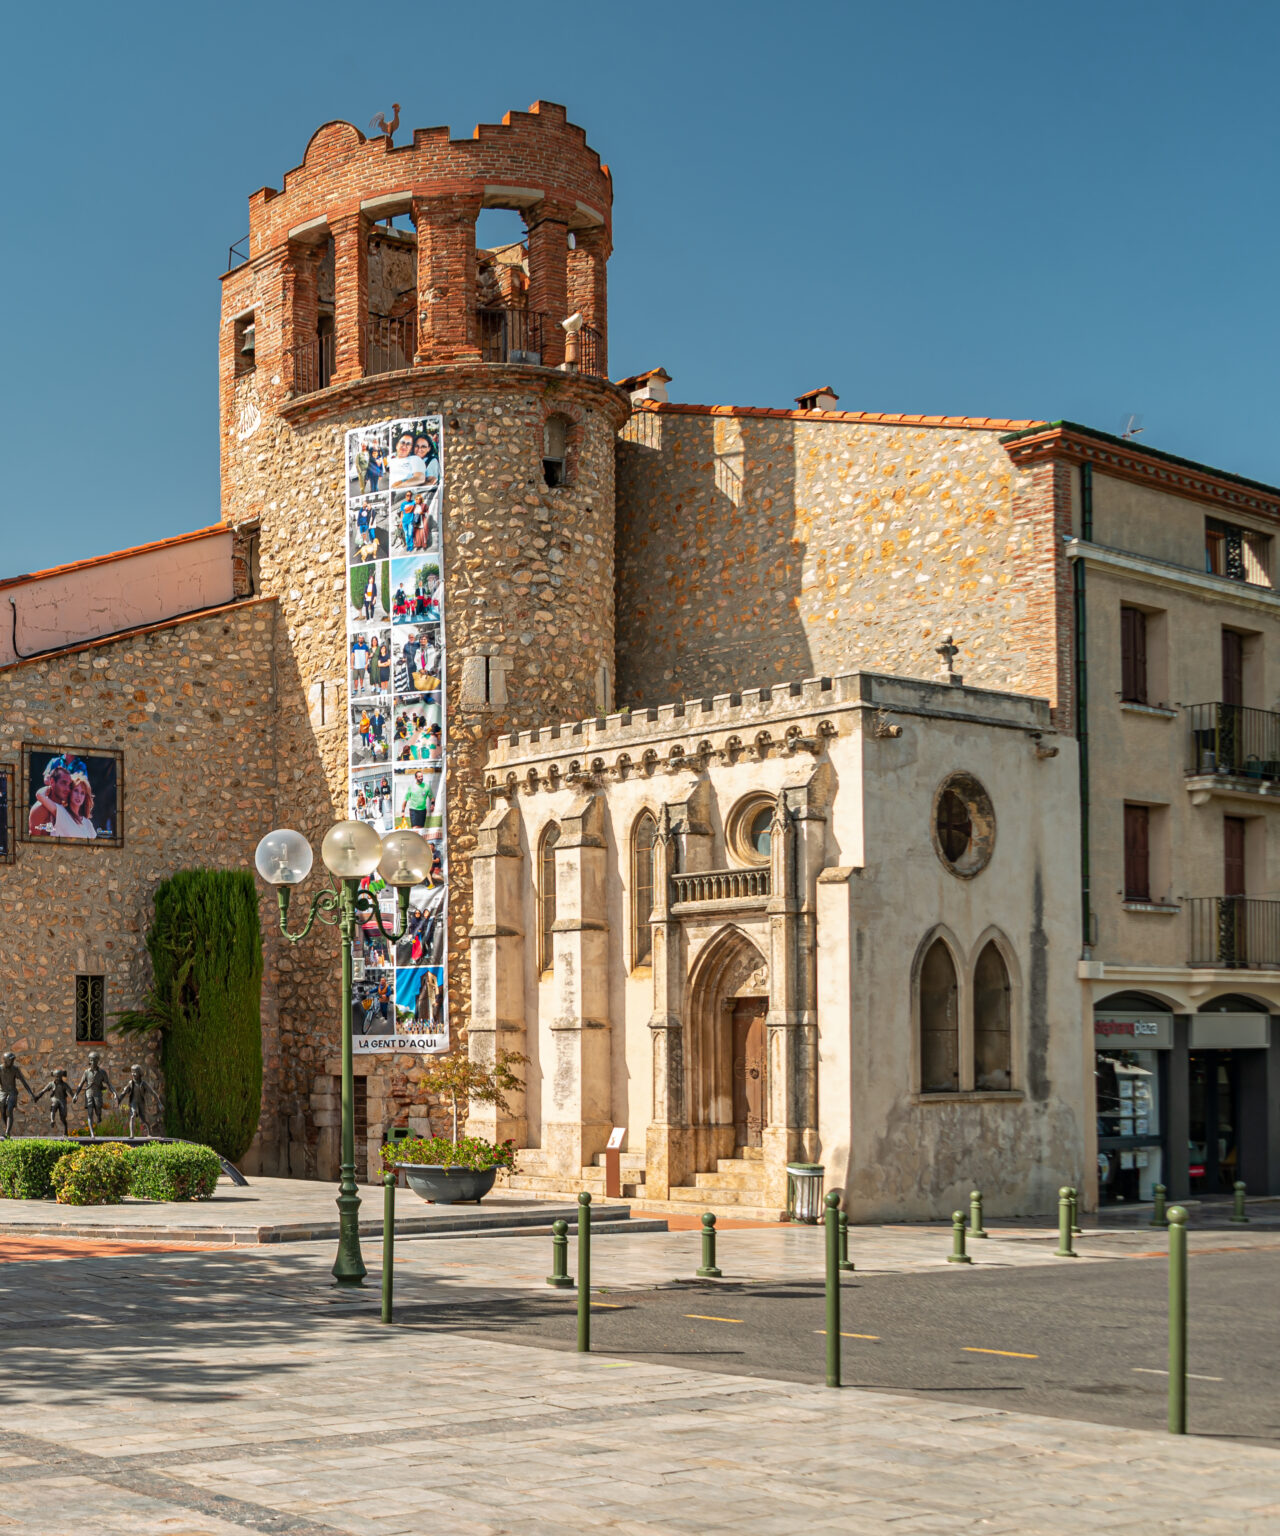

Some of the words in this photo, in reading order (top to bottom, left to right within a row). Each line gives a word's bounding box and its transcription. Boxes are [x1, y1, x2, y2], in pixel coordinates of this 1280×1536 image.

[358, 1039, 369, 1048] LA
[371, 1039, 396, 1048] GENT
[398, 1039, 437, 1048] D'AQUI
